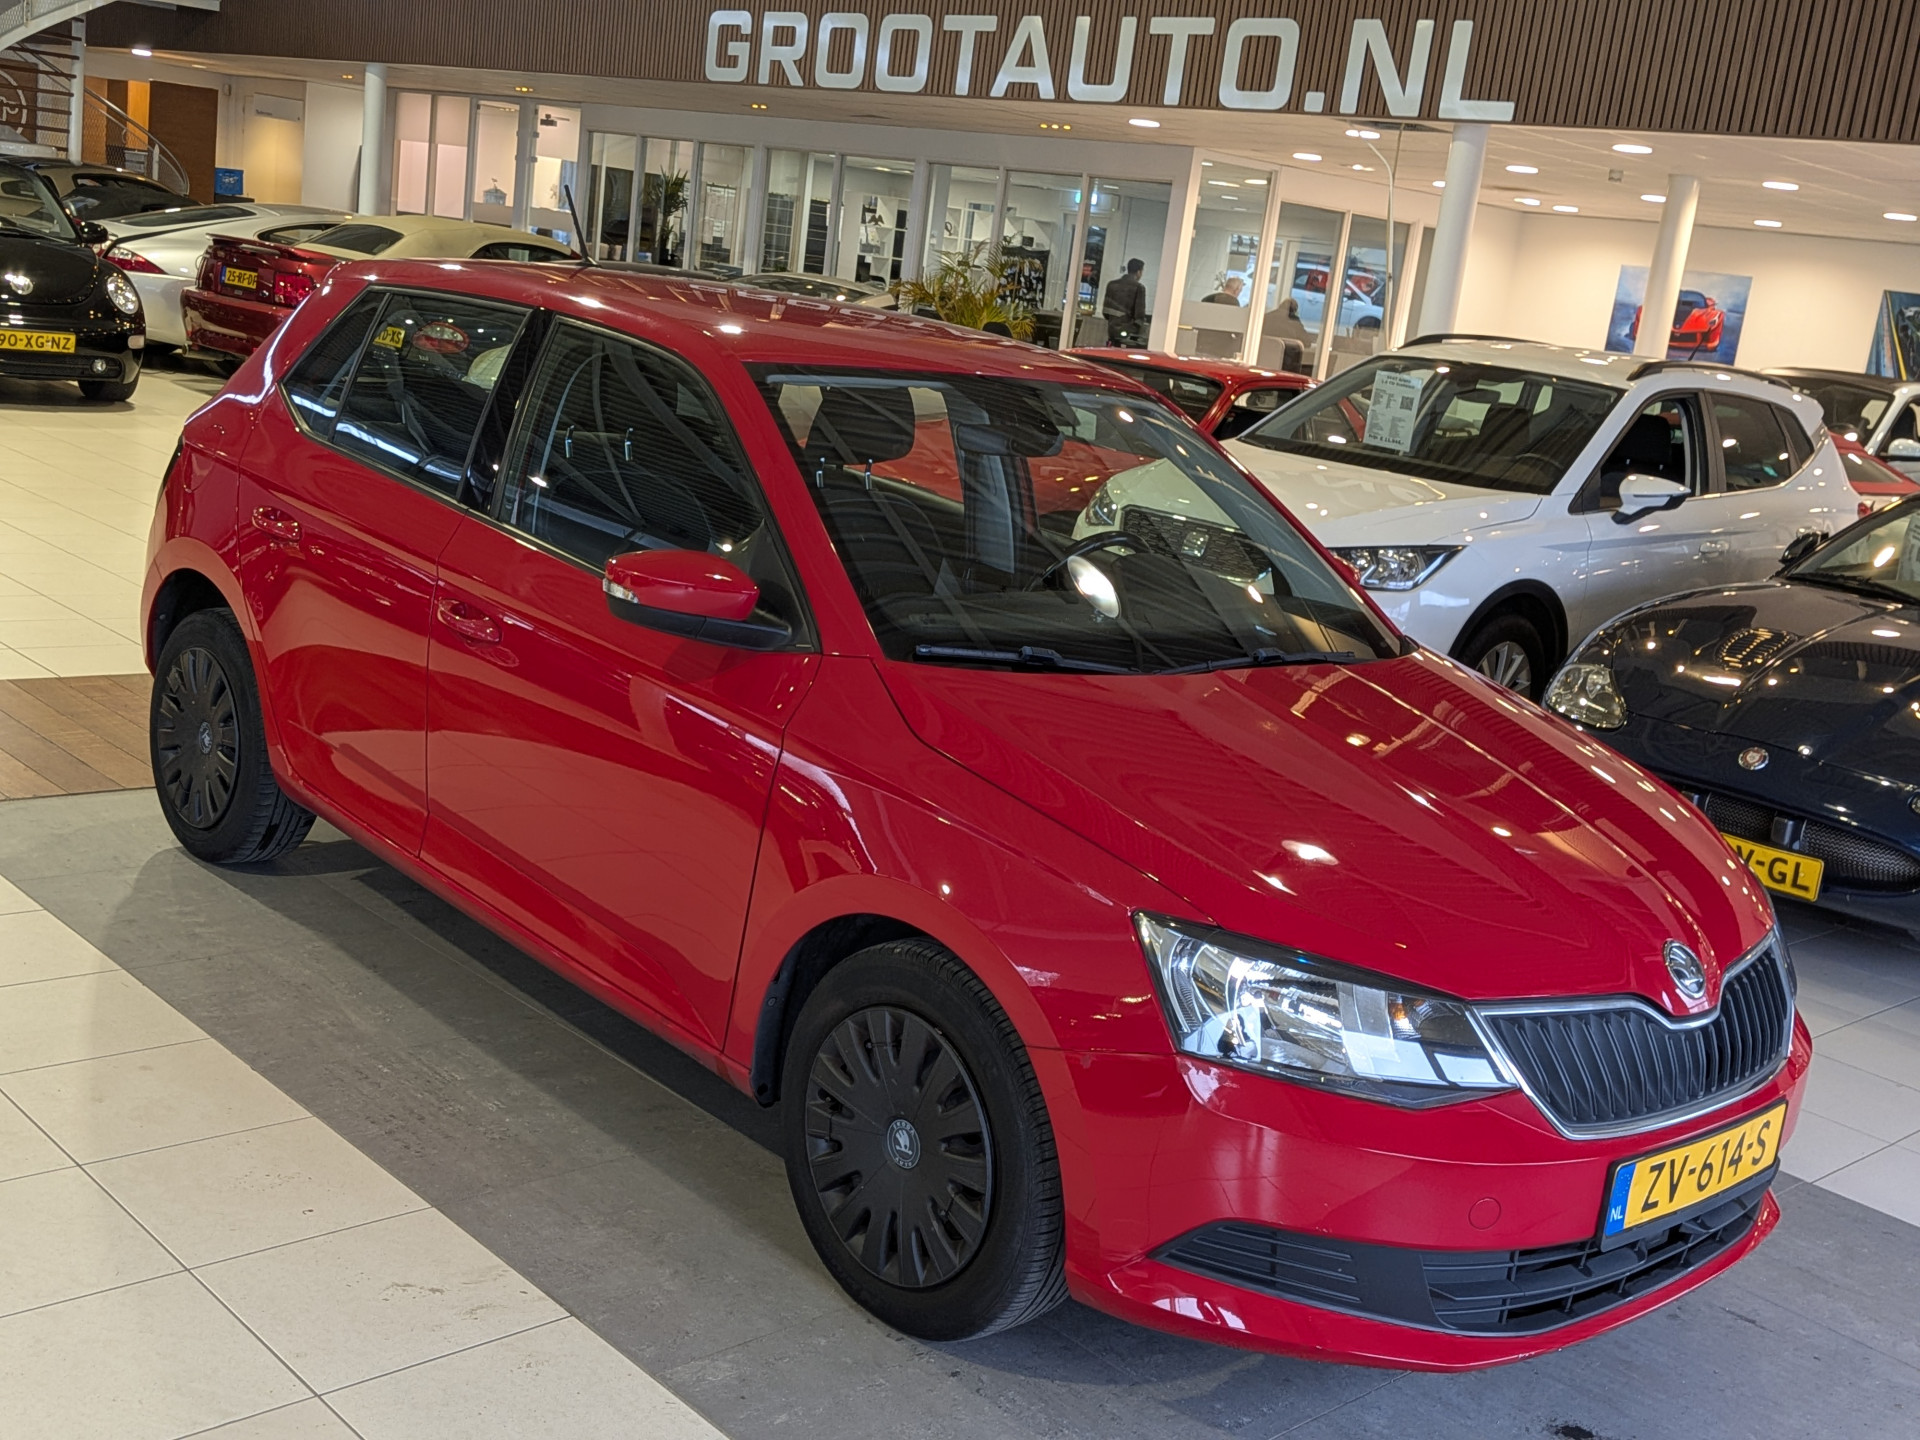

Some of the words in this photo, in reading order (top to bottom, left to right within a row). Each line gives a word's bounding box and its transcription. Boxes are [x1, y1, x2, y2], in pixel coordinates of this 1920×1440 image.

[704, 10, 1516, 122] GROOTAUTO.NL
[0, 333, 72, 351] 90-XG-NZ
[1641, 1120, 1771, 1214] ZV-614-S
[1609, 1205, 1623, 1222] NL
